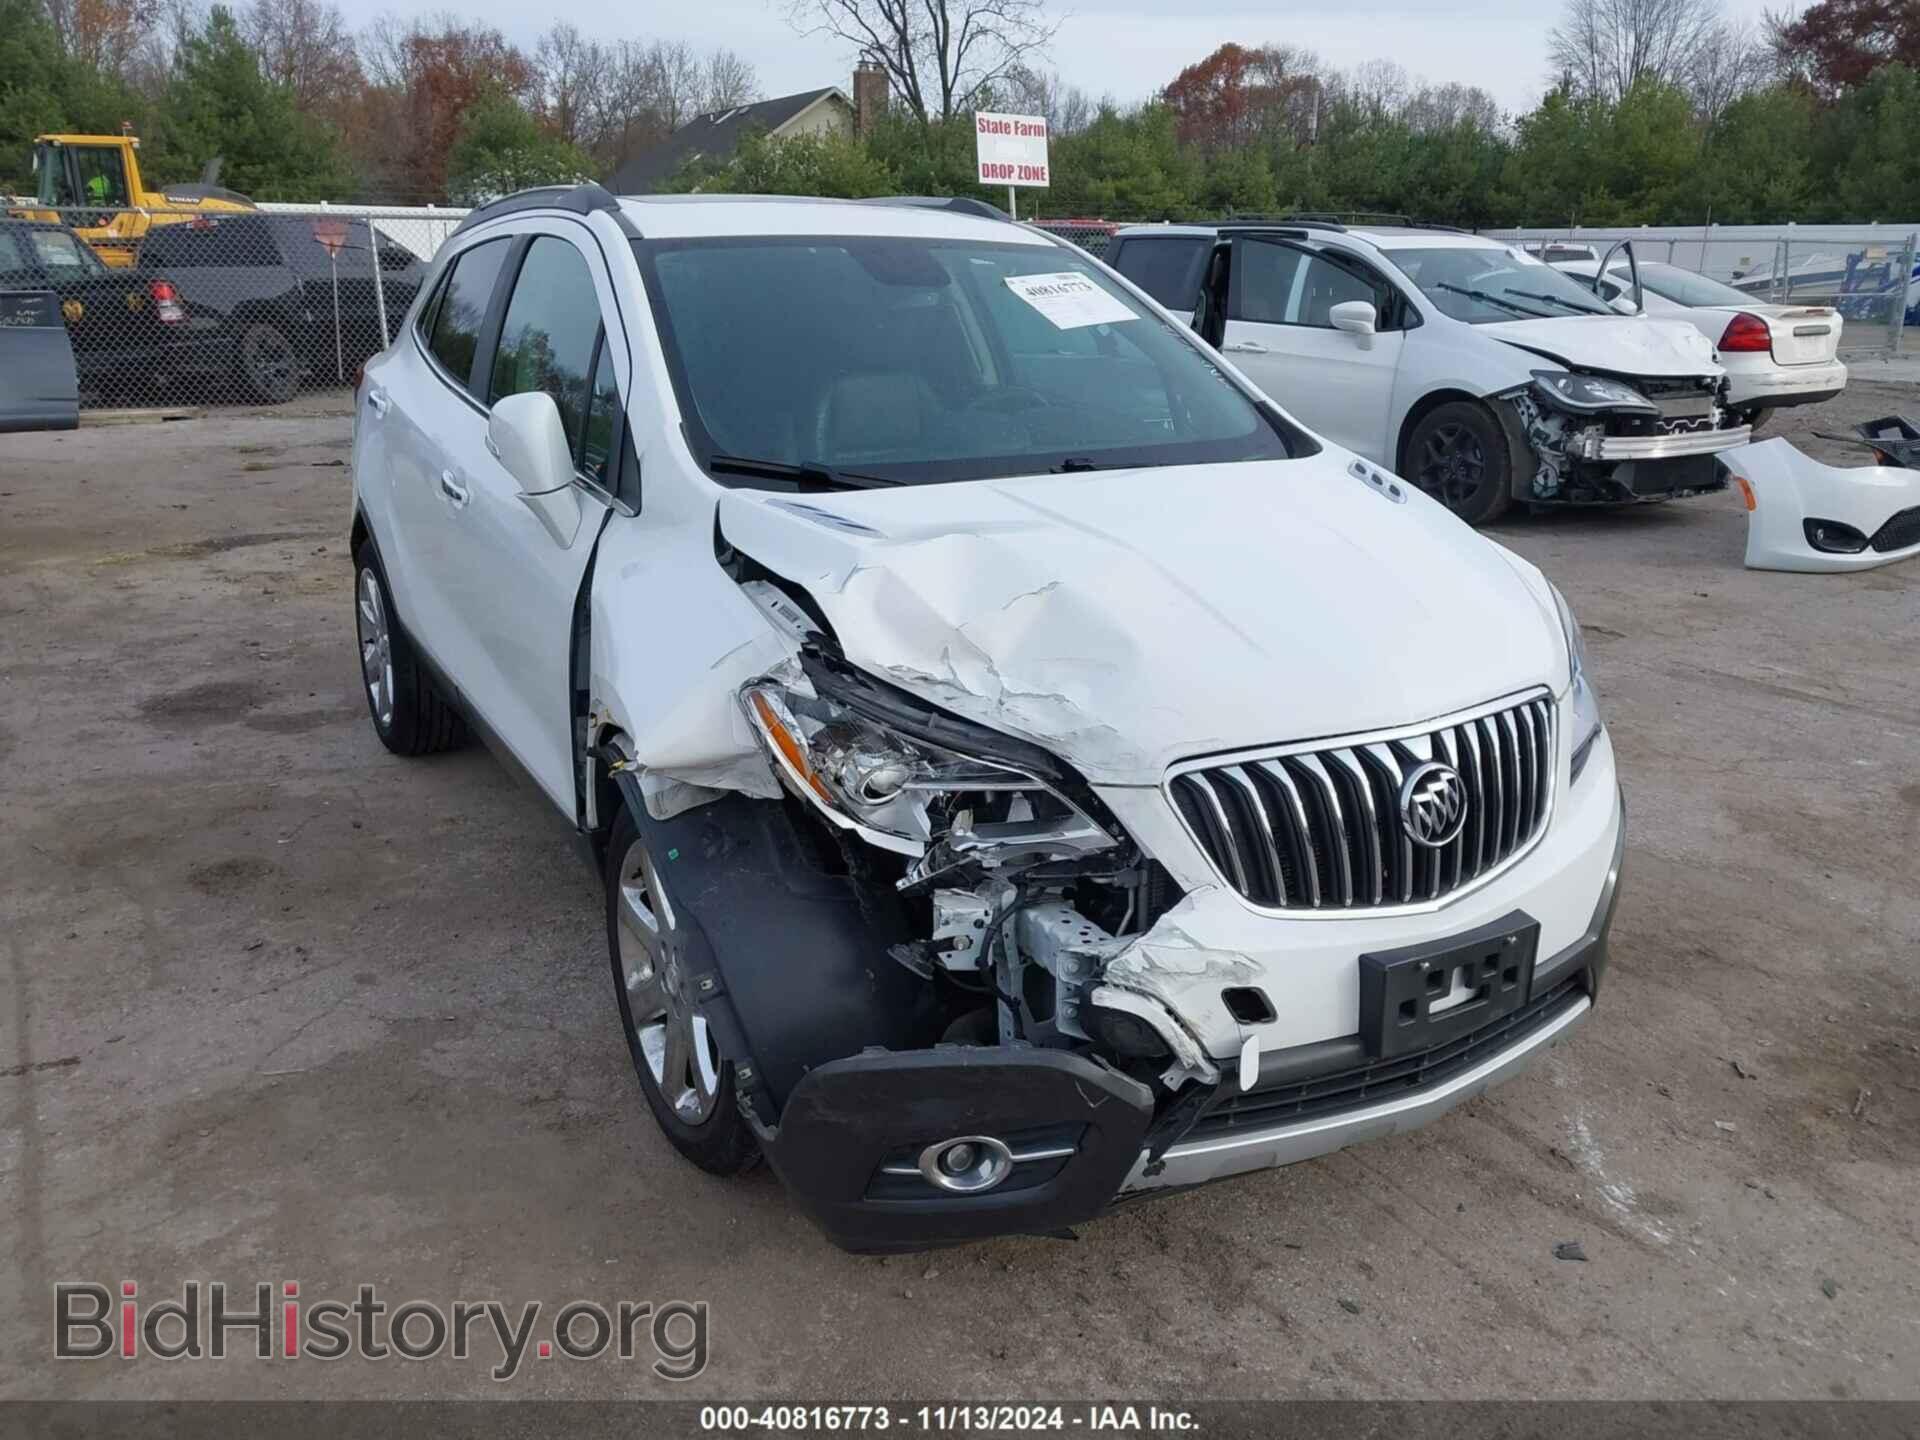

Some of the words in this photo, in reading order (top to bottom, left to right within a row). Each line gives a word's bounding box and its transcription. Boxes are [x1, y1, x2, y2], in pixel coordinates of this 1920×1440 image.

[979, 118, 1011, 135] State
[1014, 120, 1045, 137] Farm
[982, 163, 1015, 179] DROP
[1017, 165, 1047, 181] ZONE
